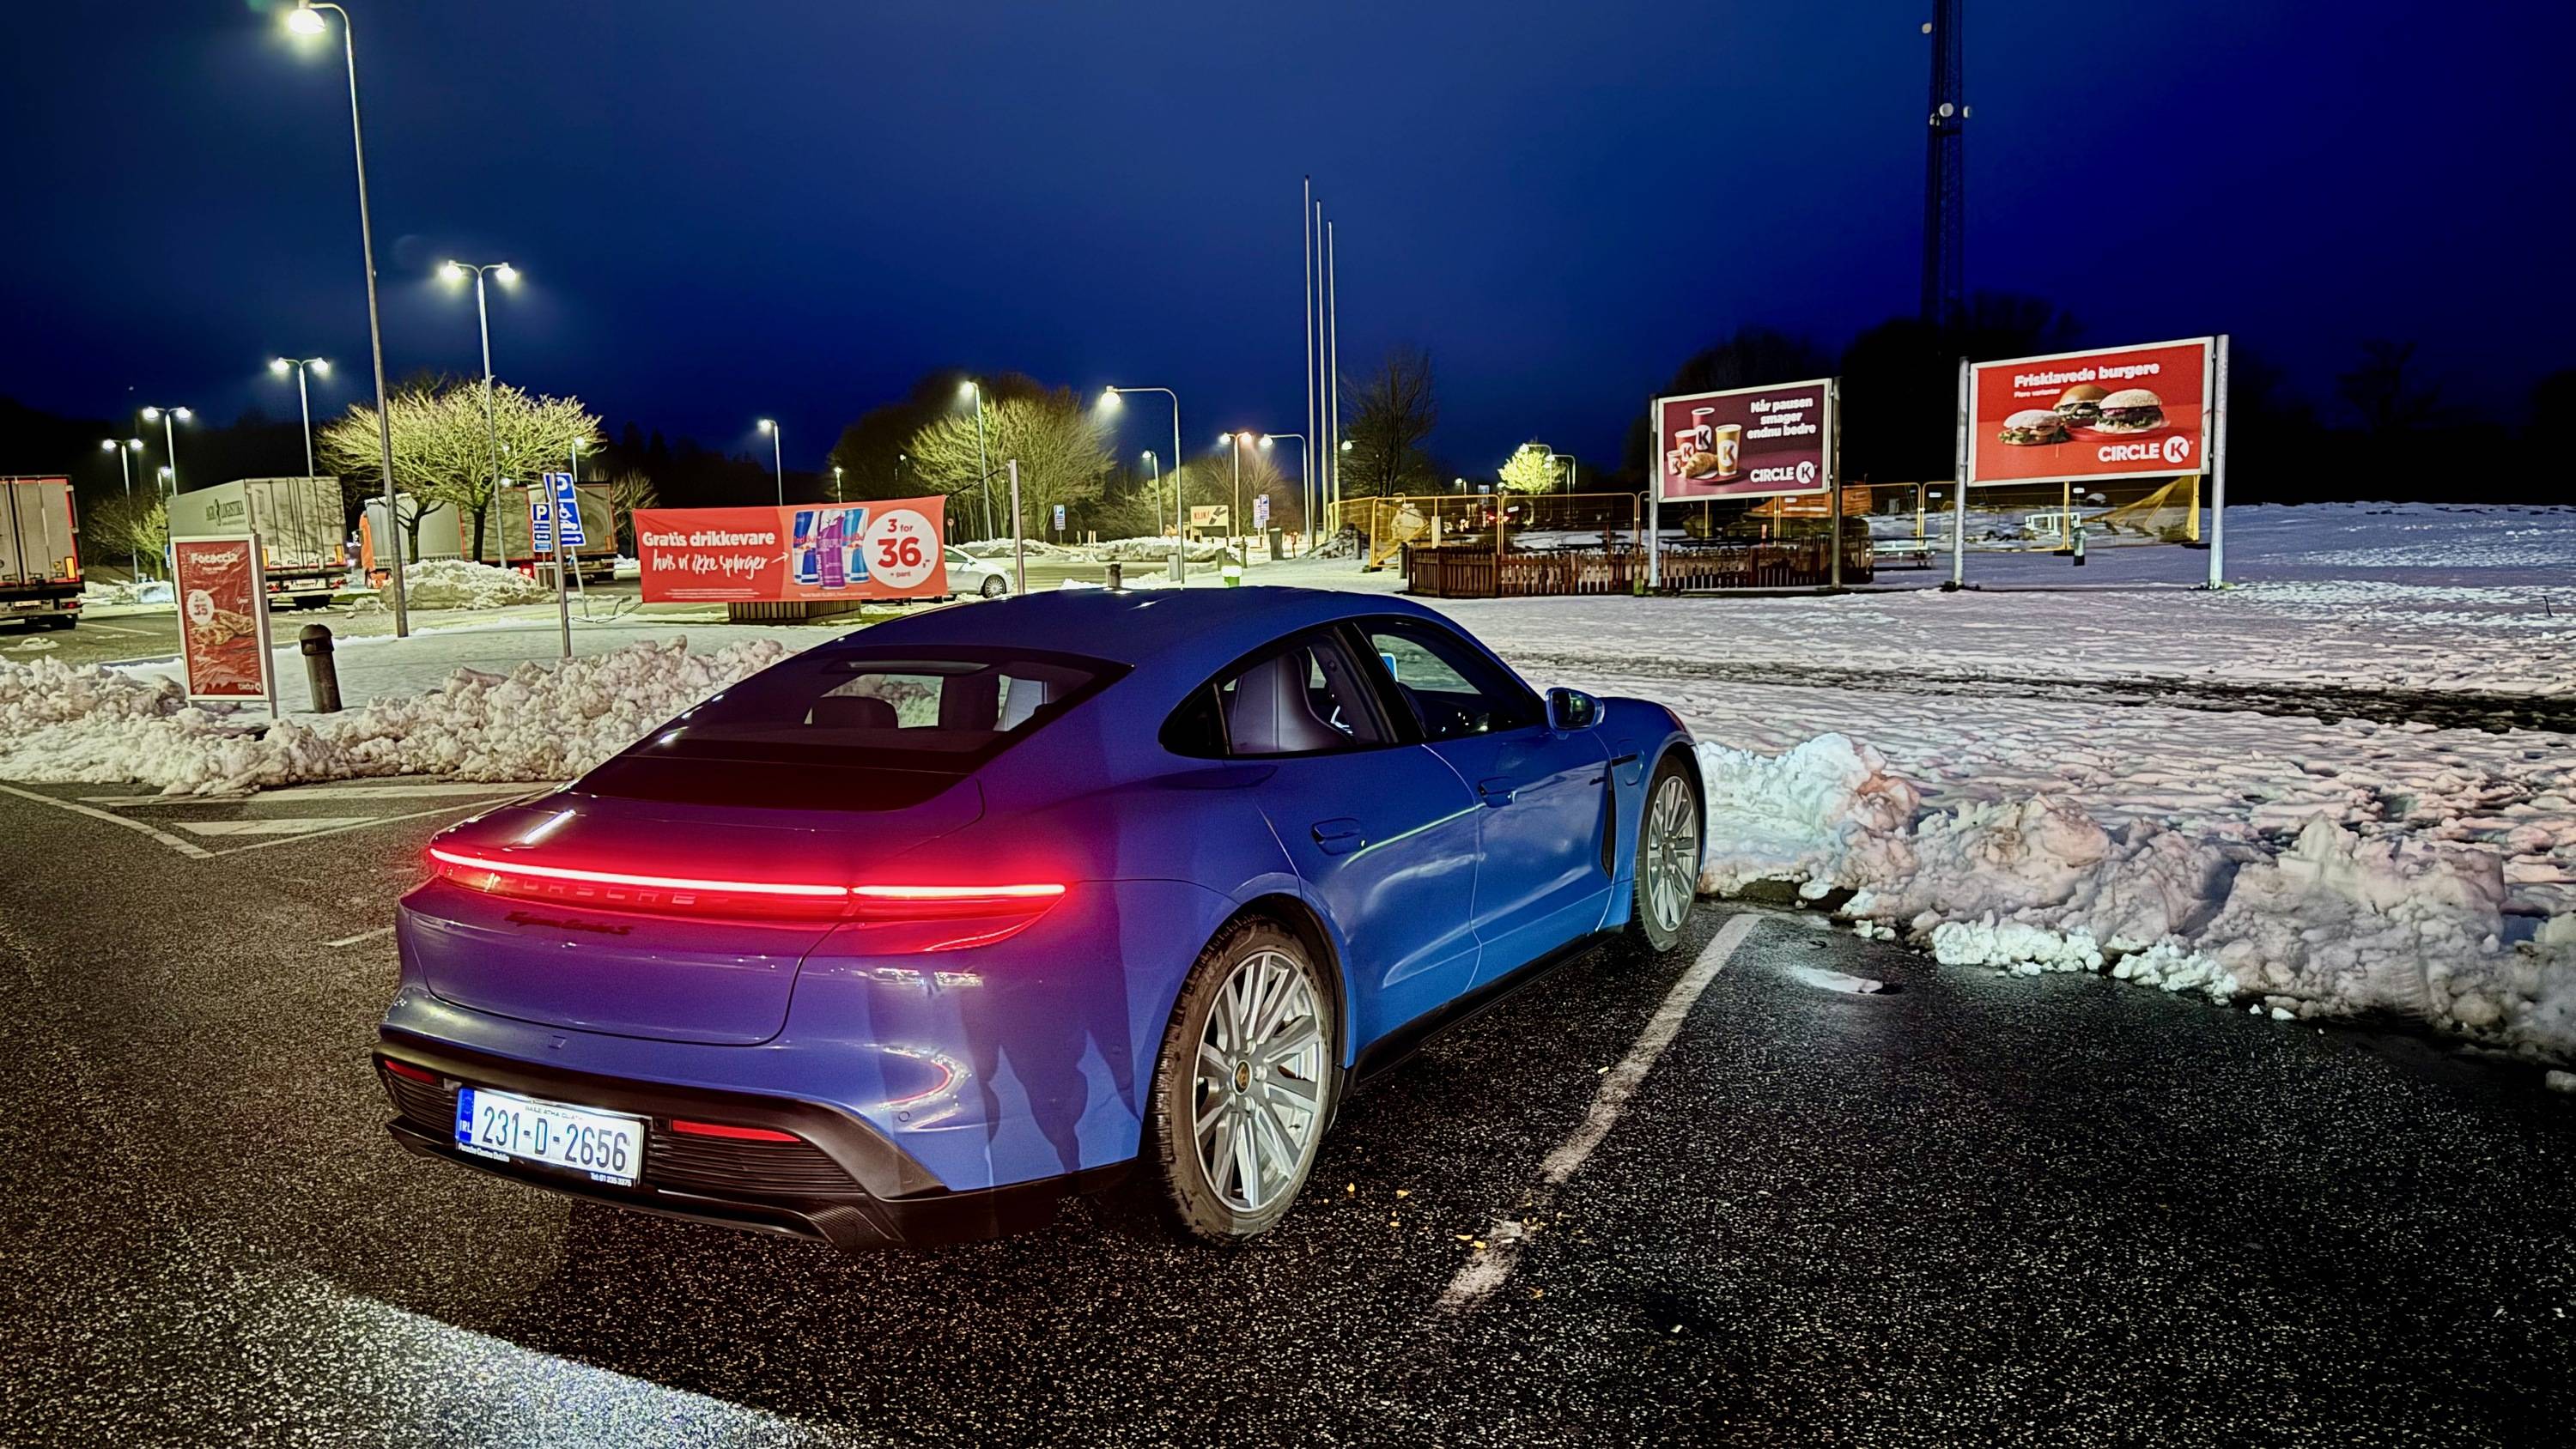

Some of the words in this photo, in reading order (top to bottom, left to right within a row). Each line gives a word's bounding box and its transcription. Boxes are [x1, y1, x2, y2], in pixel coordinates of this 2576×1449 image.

[2014, 367, 2096, 388] Frisklavede
[2098, 362, 2160, 380] burgere
[1750, 399, 1771, 413] Når
[1772, 397, 1814, 412] pausen
[1760, 411, 1802, 426] smager
[1747, 427, 1782, 440] endnu
[1783, 422, 1817, 436] bedre
[2098, 443, 2160, 462] CIRCLE
[1750, 466, 1795, 483] CIRCLE
[536, 505, 548, 520] P
[887, 518, 897, 532] 3
[900, 523, 914, 532] for
[642, 531, 688, 547] Gratis
[690, 530, 775, 547] drikkevare
[653, 549, 676, 572] hvis
[678, 554, 690, 571] vi
[692, 553, 718, 575] ikke
[720, 554, 768, 580] spørger
[193, 603, 208, 615] 35
[459, 1120, 472, 1133] IRL
[483, 1106, 631, 1172] 231-D-2656
